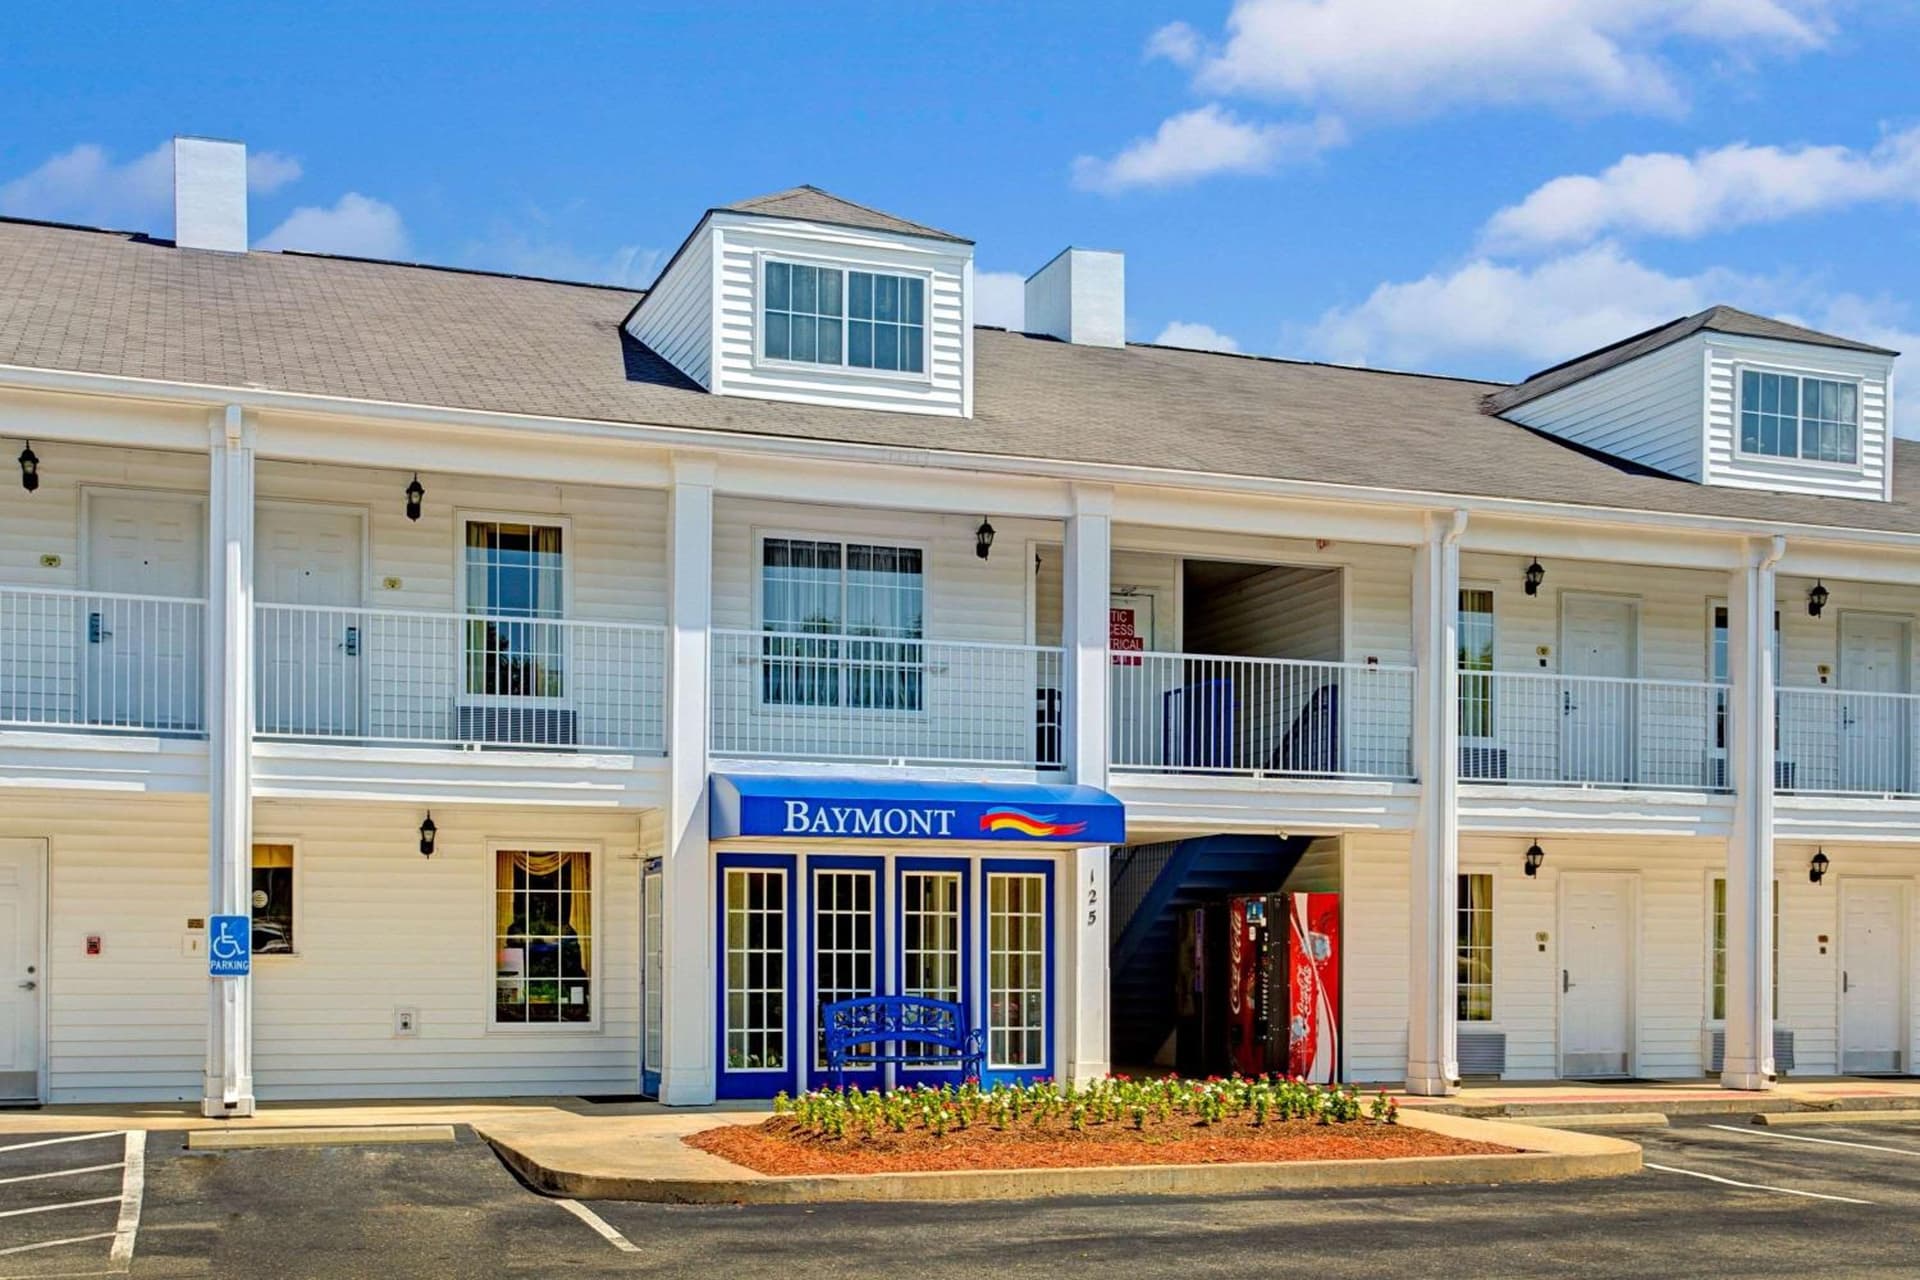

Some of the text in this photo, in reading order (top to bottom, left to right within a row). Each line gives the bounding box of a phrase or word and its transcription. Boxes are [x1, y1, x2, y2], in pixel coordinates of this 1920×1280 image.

[1111, 610, 1128, 623] TIC
[1110, 624, 1134, 636] ESS
[1110, 639, 1142, 650] RICAL
[783, 799, 956, 836] BAYMONT
[1087, 867, 1098, 927] 125
[210, 960, 249, 970] PARKING
